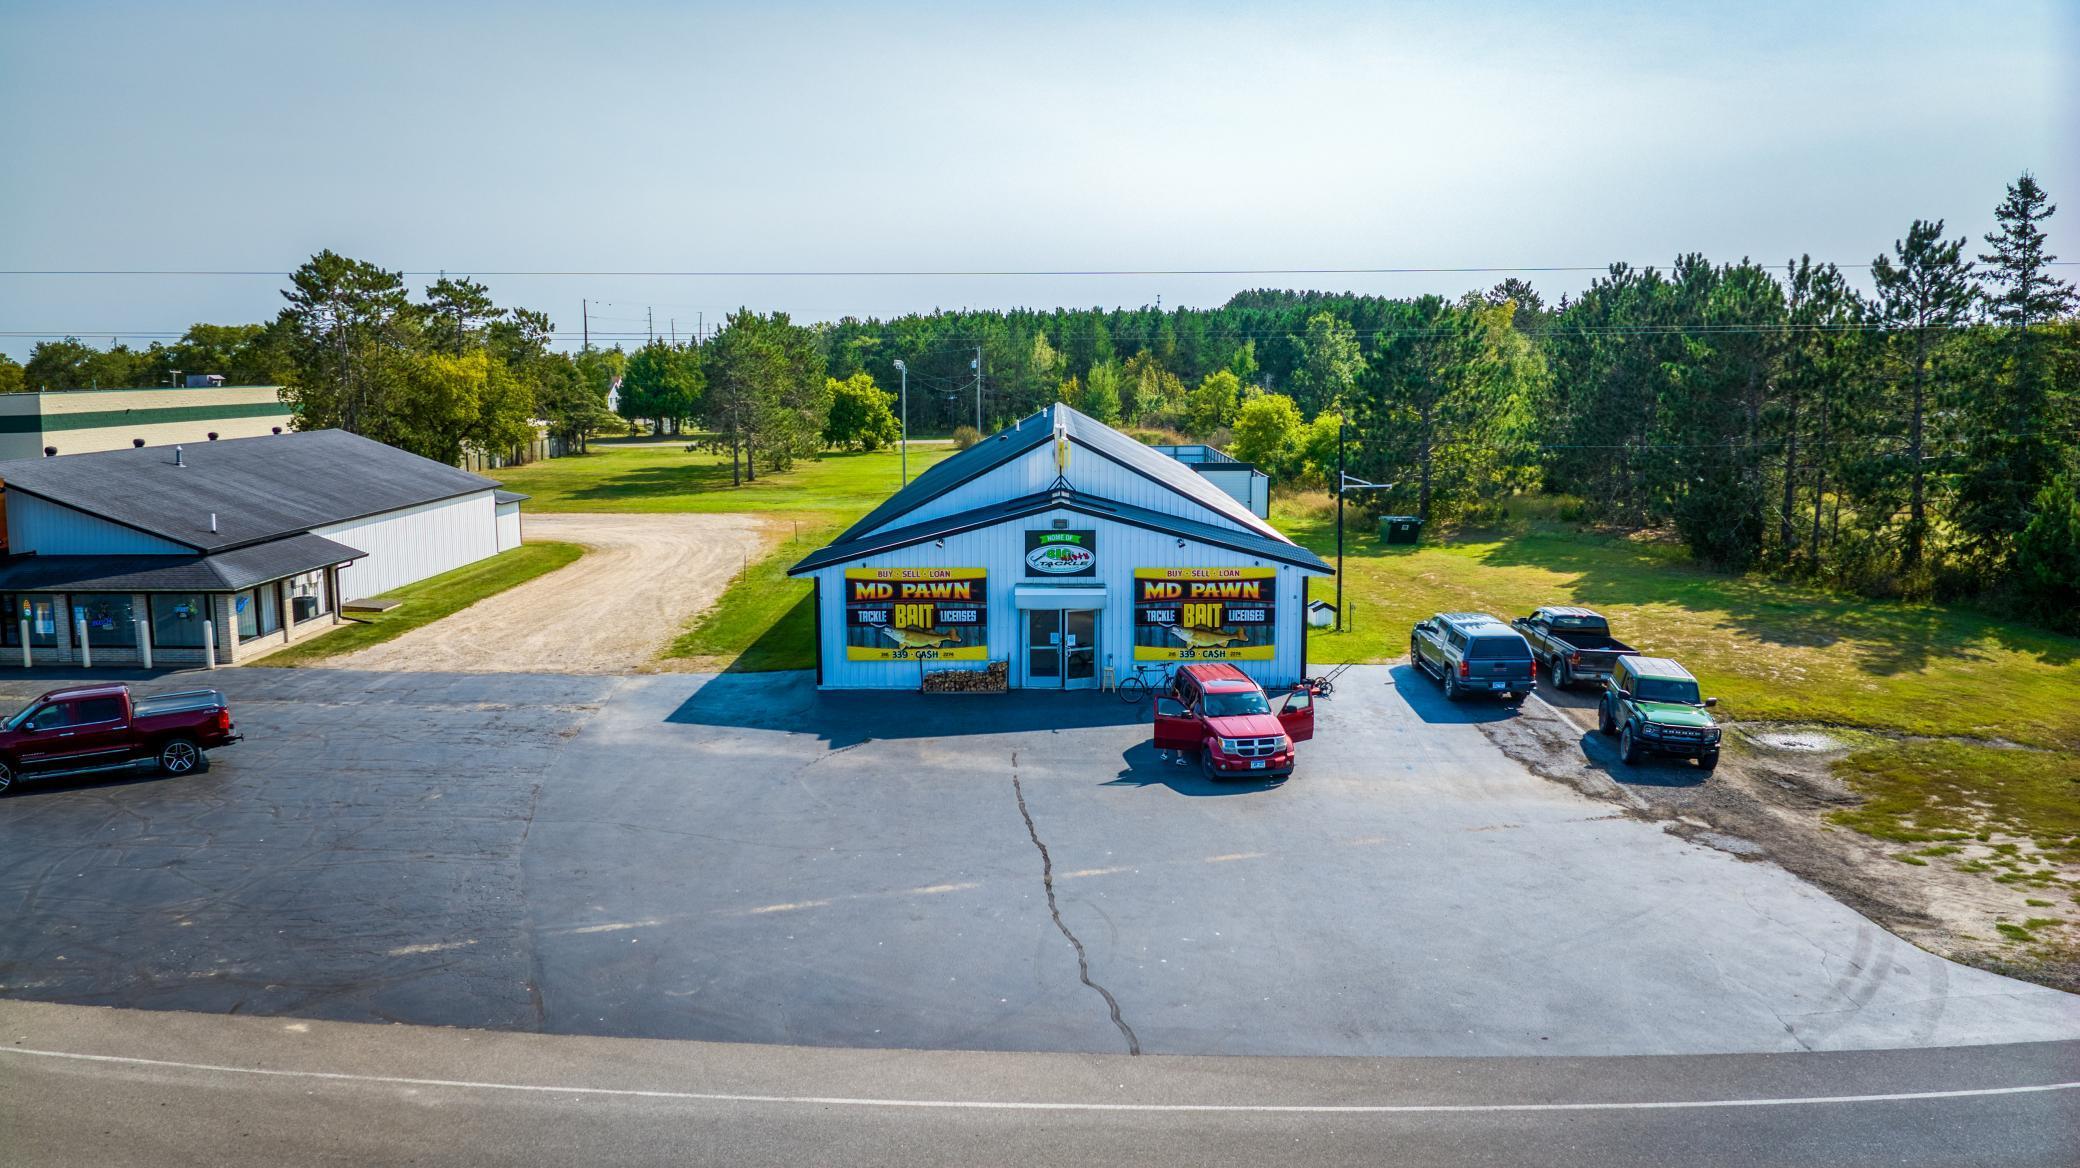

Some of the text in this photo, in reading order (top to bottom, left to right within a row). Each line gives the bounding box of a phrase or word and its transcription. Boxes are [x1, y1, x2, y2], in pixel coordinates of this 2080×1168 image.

[877, 570, 951, 578] BUY SELL LOAN
[855, 581, 971, 600] MD PAWN
[1144, 581, 1260, 599] MD PAWN
[858, 610, 887, 623] TACKLE
[895, 604, 934, 629] BAIT
[940, 610, 977, 622] LICENSES
[1146, 610, 1175, 622] TACKLE
[1183, 603, 1223, 628] BAIT
[1228, 609, 1265, 622] LICENSES
[892, 650, 908, 658] 339
[1179, 650, 1196, 658] 339
